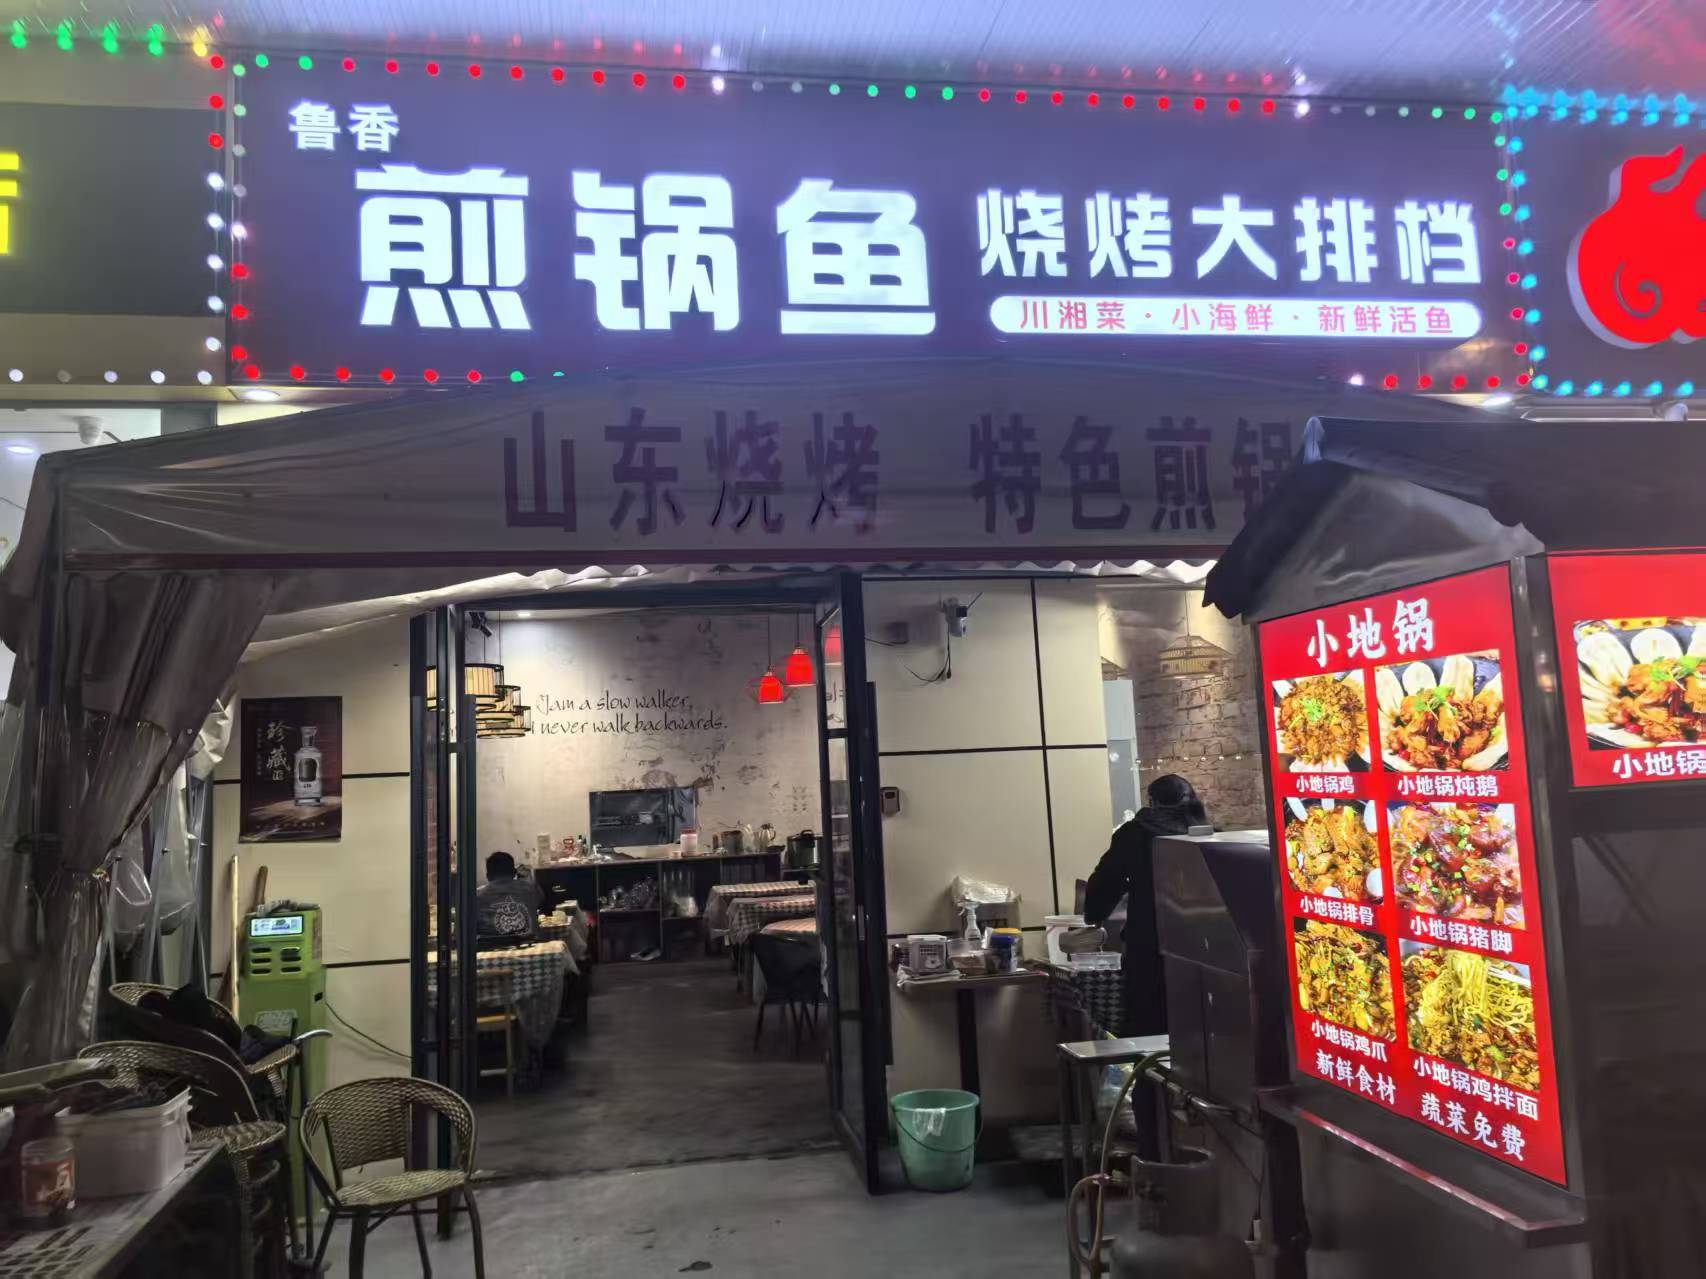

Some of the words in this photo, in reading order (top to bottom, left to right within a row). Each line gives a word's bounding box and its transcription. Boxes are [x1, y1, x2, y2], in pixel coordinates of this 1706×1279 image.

[288, 100, 400, 152] 鲁香
[354, 162, 936, 335] 煎锅鱼
[976, 188, 1482, 285] 烧烤大排档
[502, 406, 881, 536] 山东烧烤
[1307, 597, 1435, 669] 小地锅
[541, 721, 588, 735] never
[593, 713, 633, 735] walk
[597, 690, 630, 711] slow
[1295, 774, 1356, 795] 小地锅鸡
[1397, 774, 1499, 797] 小地锅炖鹅
[1612, 749, 1706, 779] 小地锅
[1299, 895, 1375, 927] 小地锅排骨
[1409, 915, 1514, 955] 小地锅猪脚
[1311, 1019, 1388, 1063] 小地锅鸡爪
[1315, 1048, 1397, 1105] 新鲜食材
[1412, 1055, 1539, 1121] 小地锅鸡拌面
[1420, 1091, 1526, 1162] 蔬菜免费
